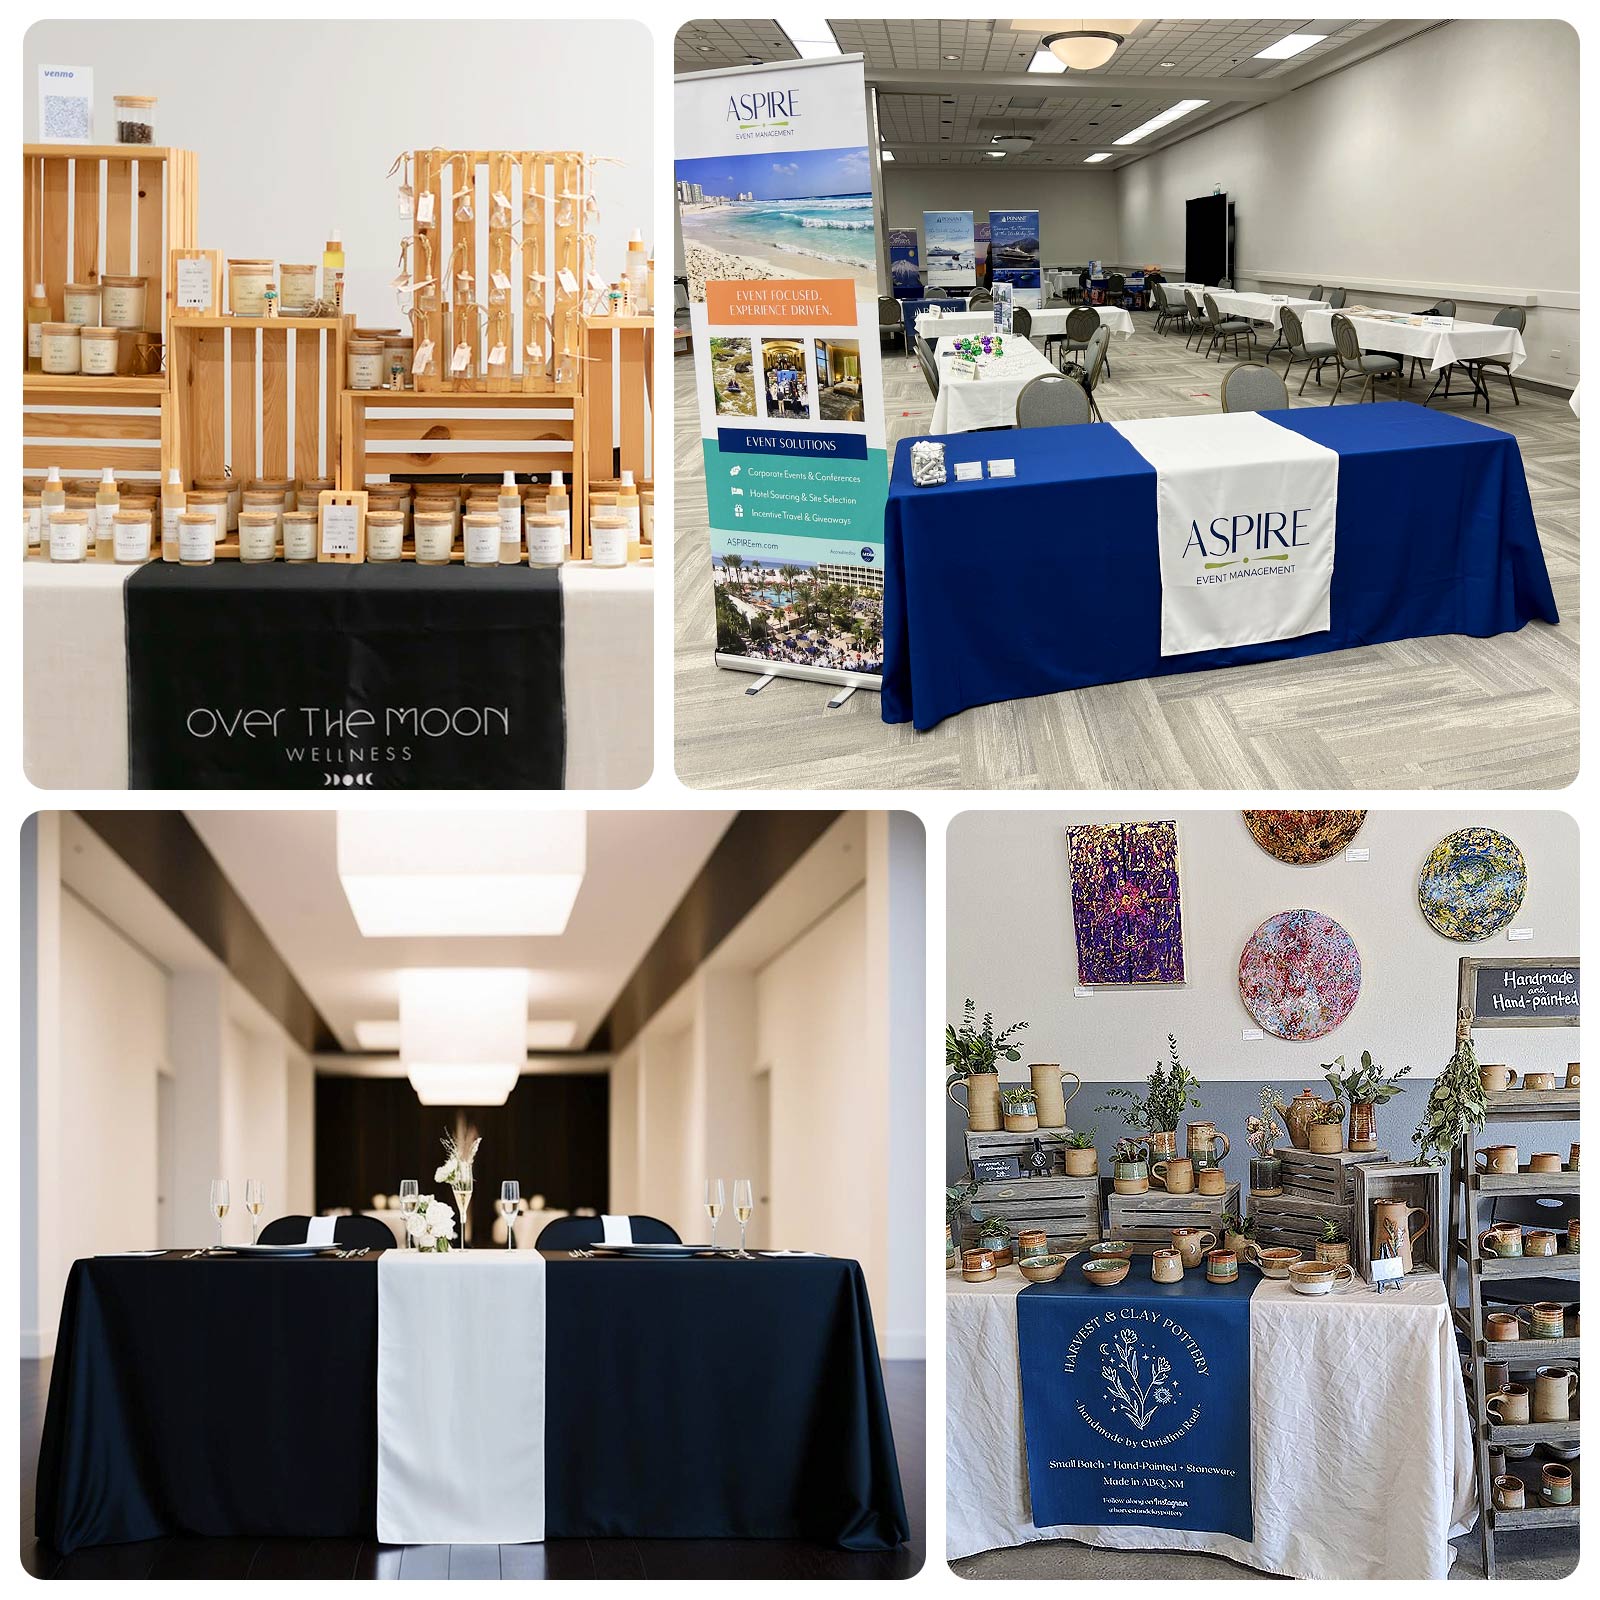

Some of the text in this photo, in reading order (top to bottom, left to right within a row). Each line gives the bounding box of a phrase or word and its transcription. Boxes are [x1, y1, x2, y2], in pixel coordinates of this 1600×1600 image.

[44, 70, 74, 78] venmo
[727, 89, 801, 122] ASPIRE
[736, 129, 795, 140] EVENT MANAGEMENT
[736, 289, 822, 301] EVENT FOCUSED.
[729, 304, 833, 316] EXPERIENCE DRIVEN.
[746, 436, 837, 451] EVENT SOLUTIONS
[747, 467, 861, 484] Corporate Events & Conferences
[749, 489, 857, 505] Hotel Sourcing & Site Selection
[751, 508, 851, 526] Incentive Travel & Giveaways
[1182, 508, 1312, 558] ASPIRE
[727, 537, 779, 550] ASPIREem.com
[1196, 565, 1296, 585] EVENT MANAGEMENT
[386, 706, 509, 737] MOON
[286, 746, 413, 762] WELLNESS
[1503, 970, 1575, 989] Handmade
[1527, 986, 1548, 995] and
[1492, 989, 1580, 1011] Hand-painted
[1064, 1308, 1210, 1377] HARVEST & CLAY POTTERY
[1125, 1437, 1139, 1449] by
[1140, 1428, 1186, 1448] Christina
[1049, 1459, 1236, 1477] Small Batch Hand-Painted Stoneware
[1103, 1476, 1130, 1486] Made
[1130, 1477, 1140, 1486] in
[1168, 1478, 1184, 1489] NM
[1125, 1497, 1145, 1506] along
[1153, 1497, 1189, 1509] Instagram
